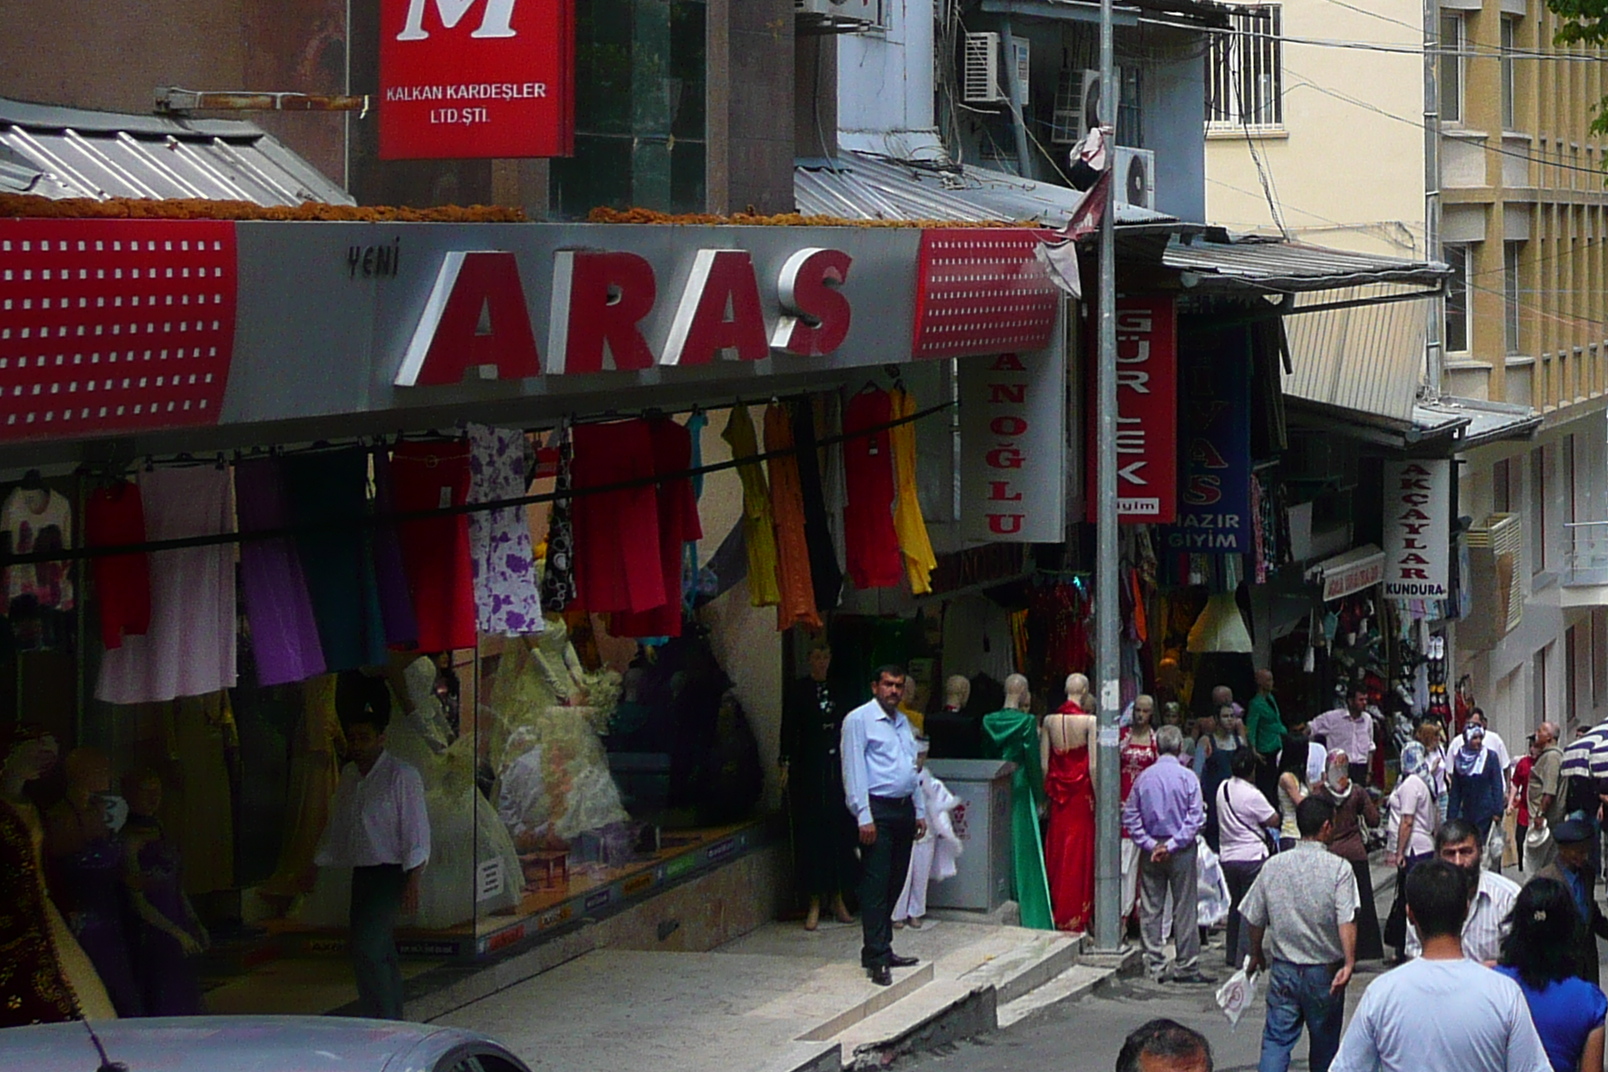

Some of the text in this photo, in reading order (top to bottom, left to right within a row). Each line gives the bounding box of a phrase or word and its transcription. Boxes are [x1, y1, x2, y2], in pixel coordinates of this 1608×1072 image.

[386, 81, 547, 103] KALKAN KARDEŞLER
[347, 236, 401, 277] YENİ
[395, 247, 853, 388] ARAS
[1116, 501, 1156, 512] iyim
[1397, 463, 1433, 581] AKÇAYLAR
[1167, 530, 1238, 550] GİYİM
[1385, 582, 1444, 596] KUNDURA
